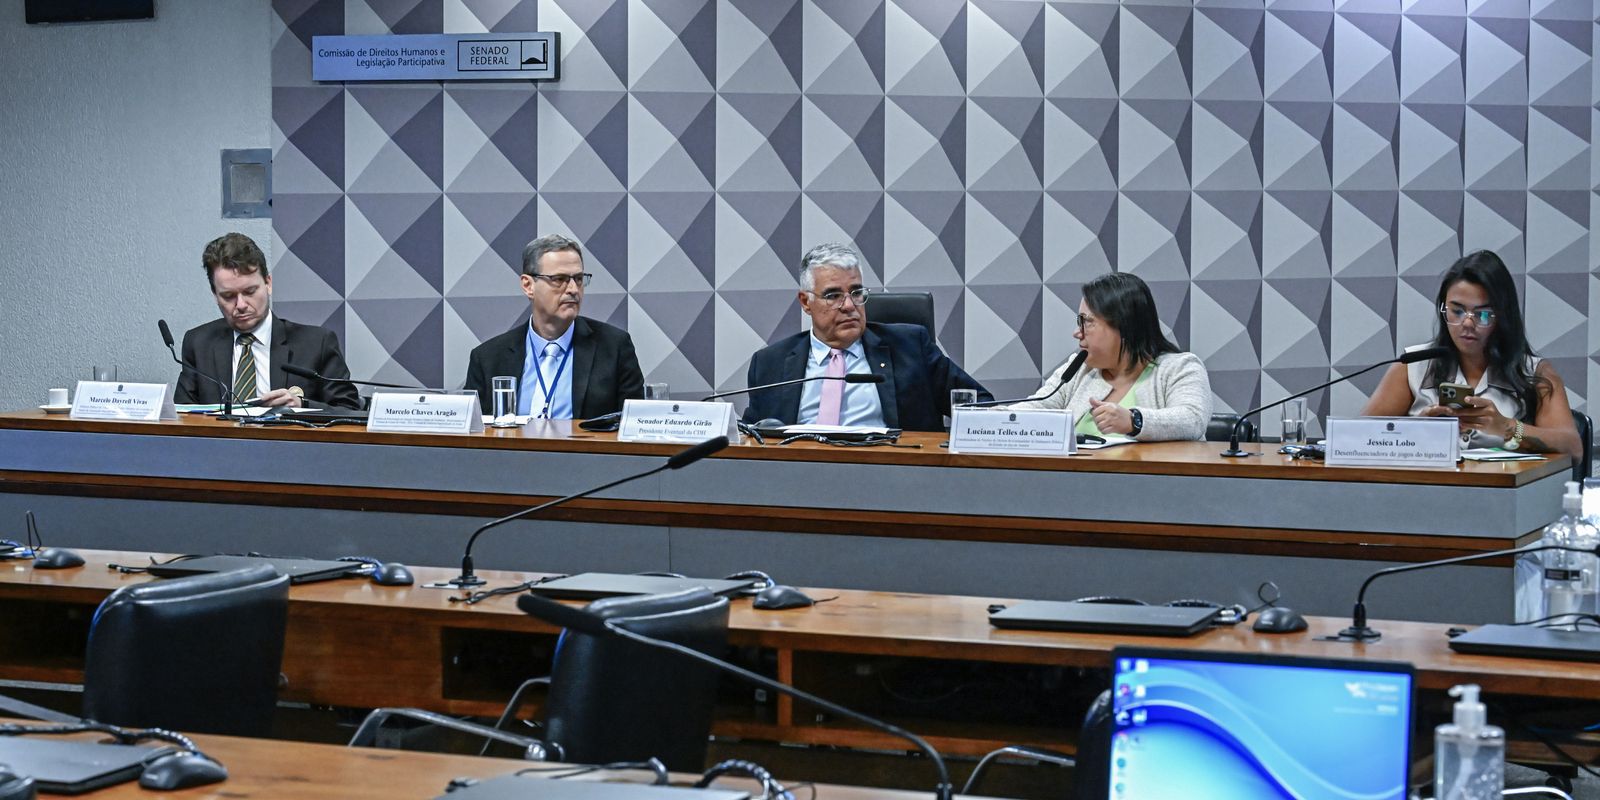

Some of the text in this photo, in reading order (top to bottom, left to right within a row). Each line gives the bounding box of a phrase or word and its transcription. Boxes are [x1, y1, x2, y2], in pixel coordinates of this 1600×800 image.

[318, 48, 355, 58] Comissão
[357, 48, 366, 56] de
[370, 48, 398, 56] Direitos
[401, 48, 438, 56] Humanos
[470, 46, 509, 55] SENADO
[356, 58, 445, 68] Legislação Participativa
[470, 56, 509, 65] FEDERAL
[434, 408, 457, 416] Aragão
